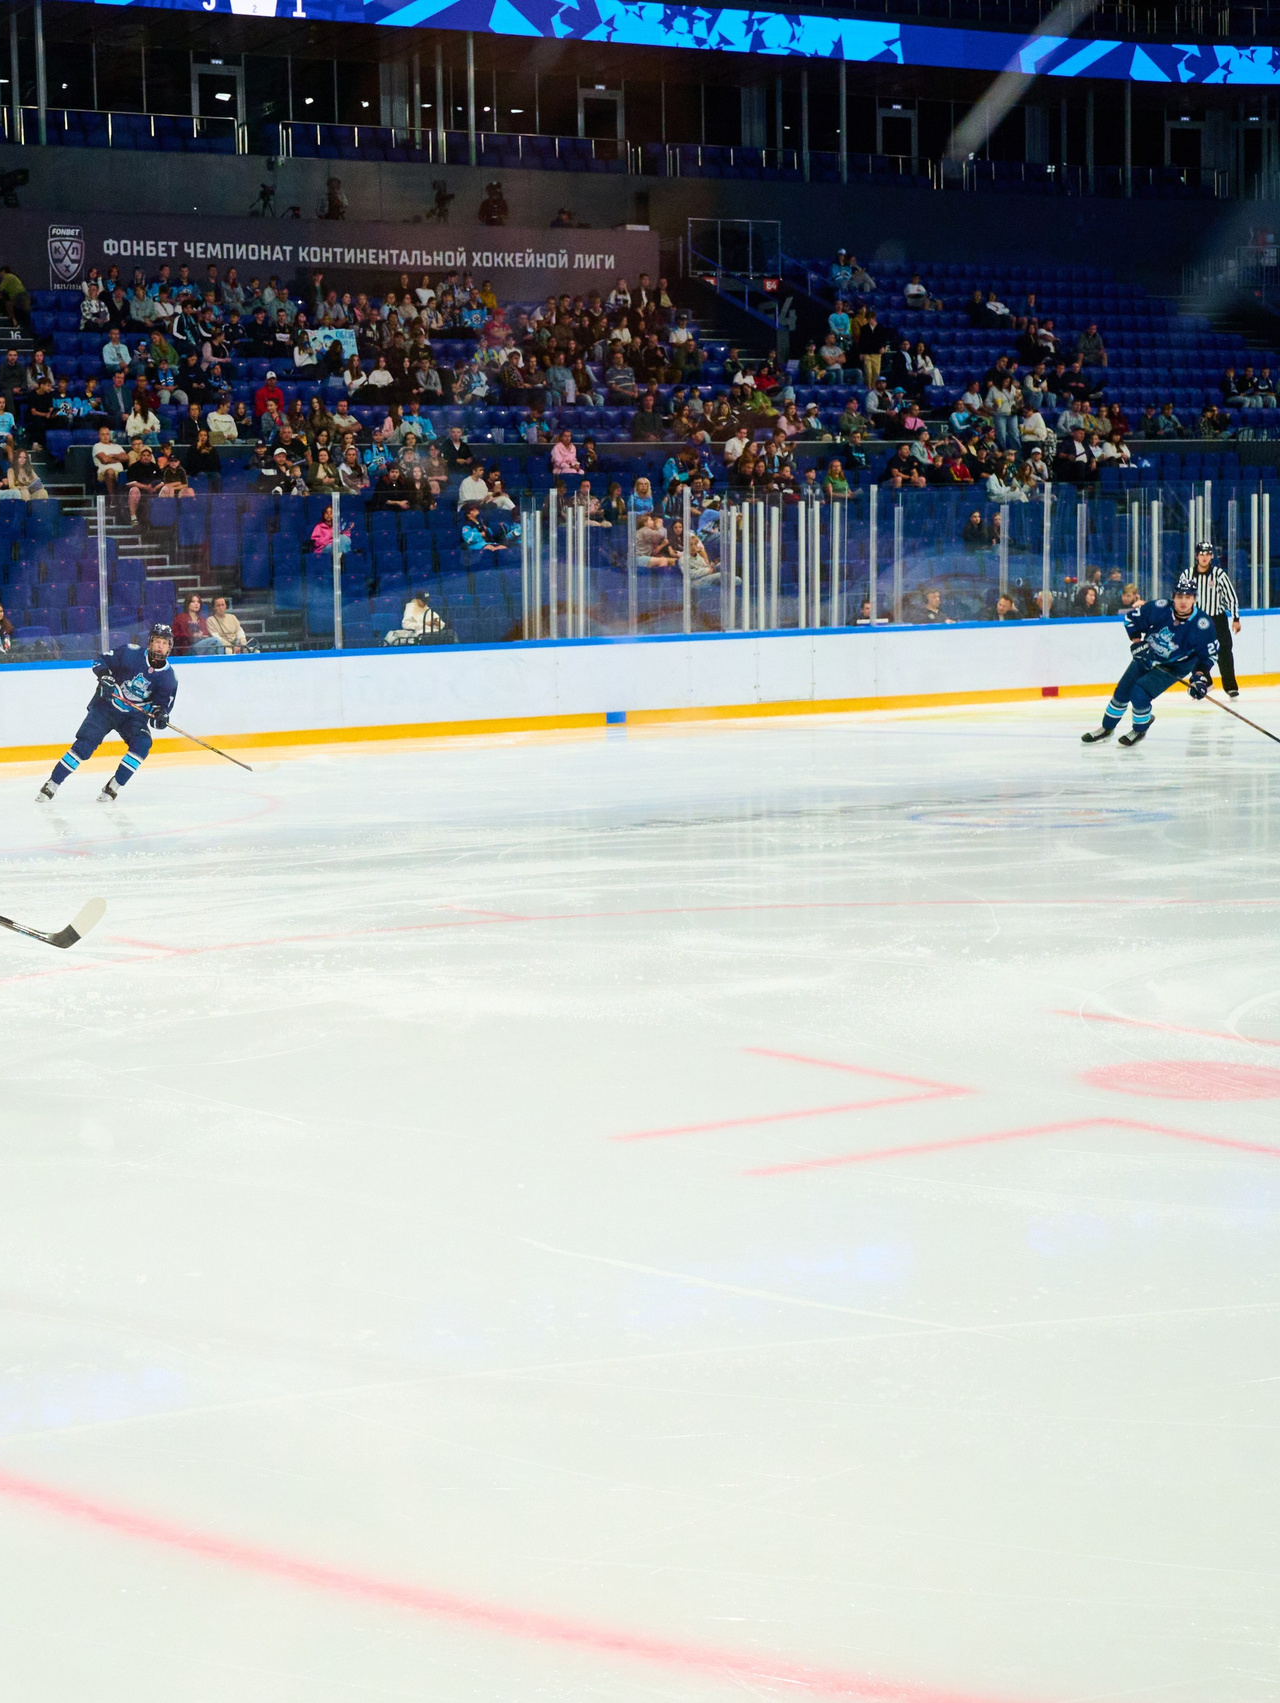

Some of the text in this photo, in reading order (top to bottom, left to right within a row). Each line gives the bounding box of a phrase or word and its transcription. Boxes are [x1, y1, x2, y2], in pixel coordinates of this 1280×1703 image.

[51, 227, 80, 236] FONBET
[103, 238, 616, 270] ФОНБЕТ ЧЕМПИОНАТ КОНТИНЕНТАЛЬНОЙ ХОККЕЙНОЙ ЛИГИ
[10, 330, 22, 340] 16
